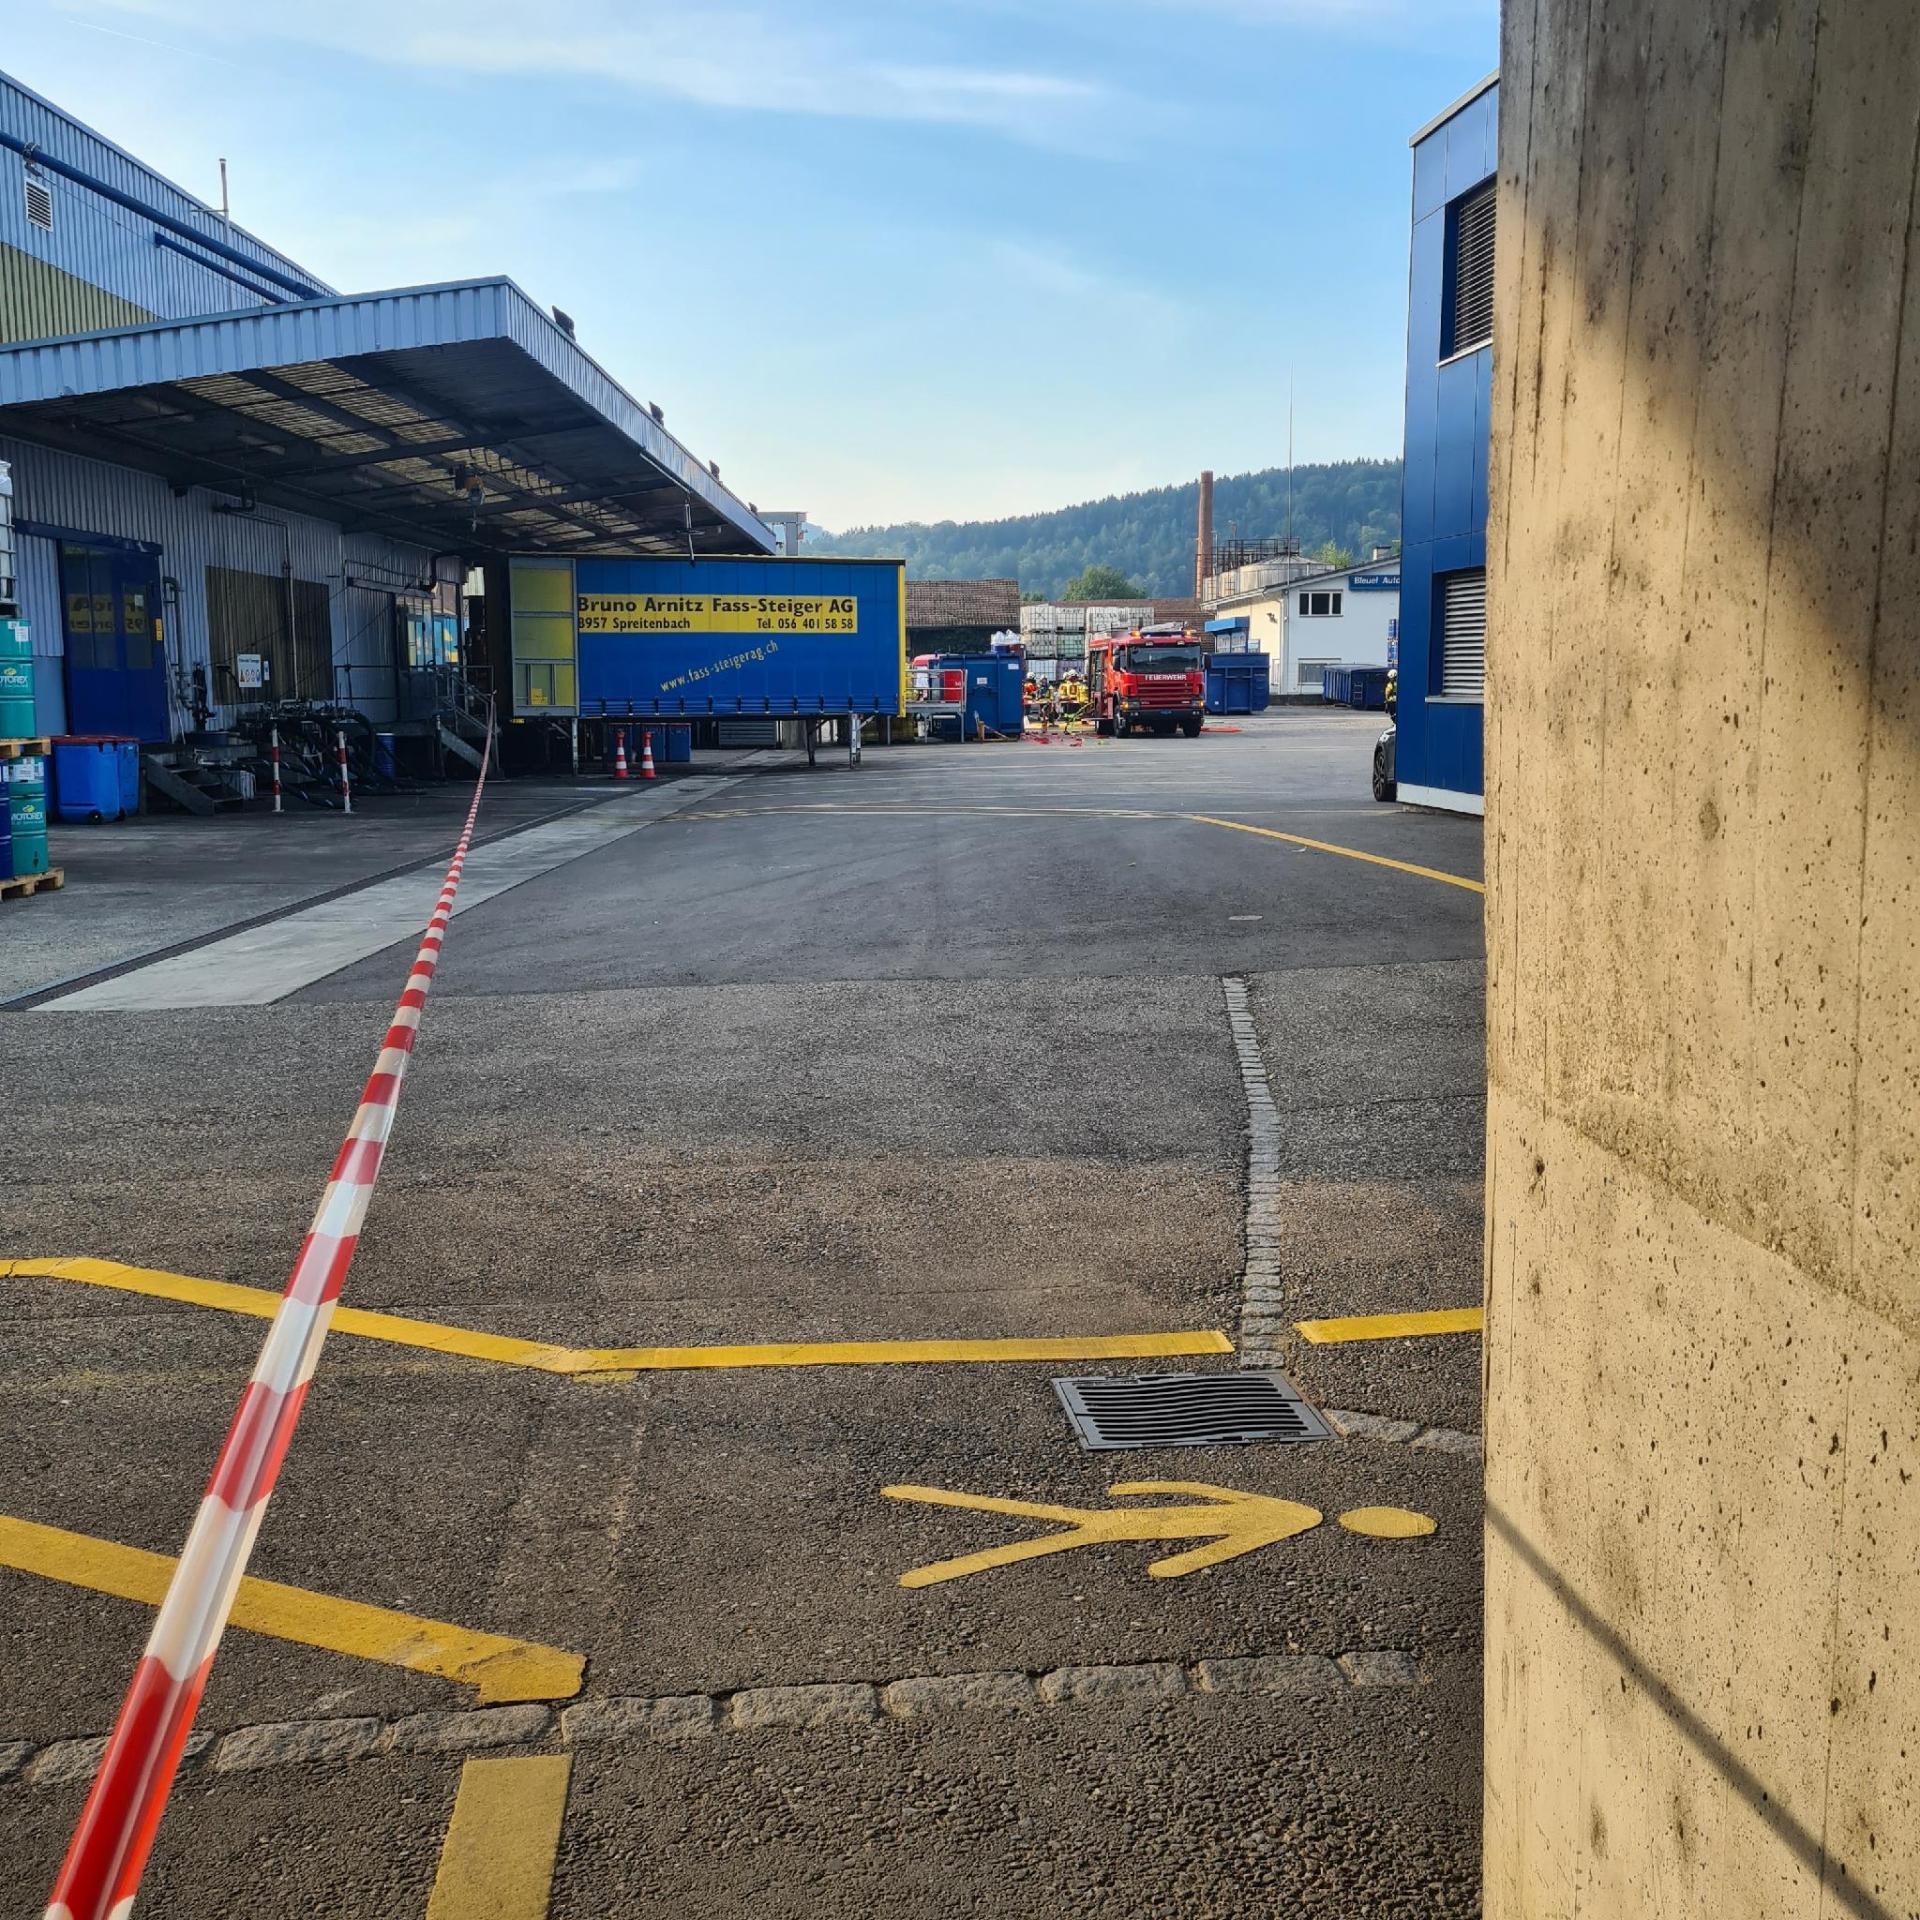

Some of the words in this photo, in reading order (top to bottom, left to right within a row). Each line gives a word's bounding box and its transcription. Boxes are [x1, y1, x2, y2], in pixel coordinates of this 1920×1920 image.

[578, 597, 637, 612] Bruno
[644, 597, 704, 612] Arnitz
[712, 597, 822, 617] Fass-Steiger
[829, 599, 854, 613] AG
[578, 617, 608, 629] 8957
[613, 617, 690, 632] Spreitenbach
[756, 618, 774, 629] Tel.
[778, 618, 797, 629] 056
[802, 618, 820, 629] 401
[825, 618, 837, 629] 58
[841, 618, 854, 629] 58
[659, 639, 779, 692] www.fass-steigerag.ch
